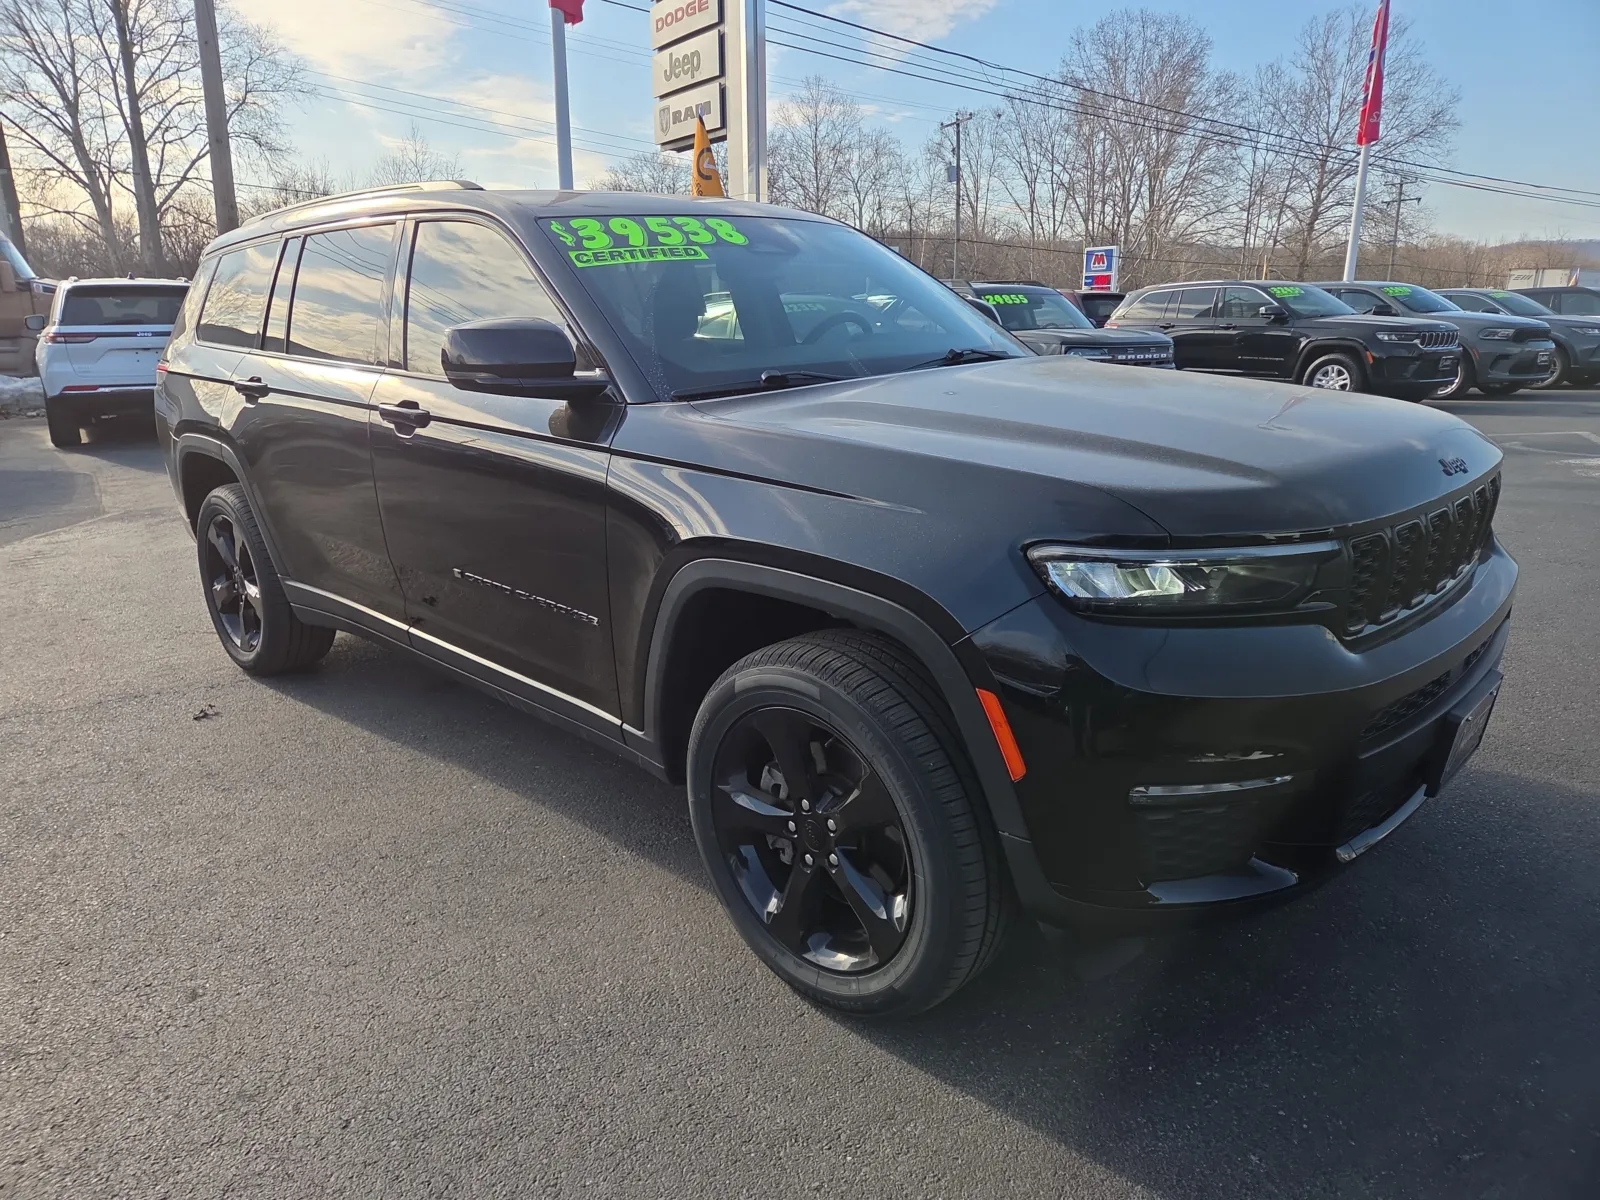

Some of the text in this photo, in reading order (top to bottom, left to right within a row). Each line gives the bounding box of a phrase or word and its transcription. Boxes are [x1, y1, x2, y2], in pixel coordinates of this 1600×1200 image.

[655, 0, 709, 33] DODGE
[664, 49, 701, 82] Jeep
[672, 101, 711, 125] RAM
[551, 217, 749, 249] $39538
[574, 247, 700, 265] CERTIFIED
